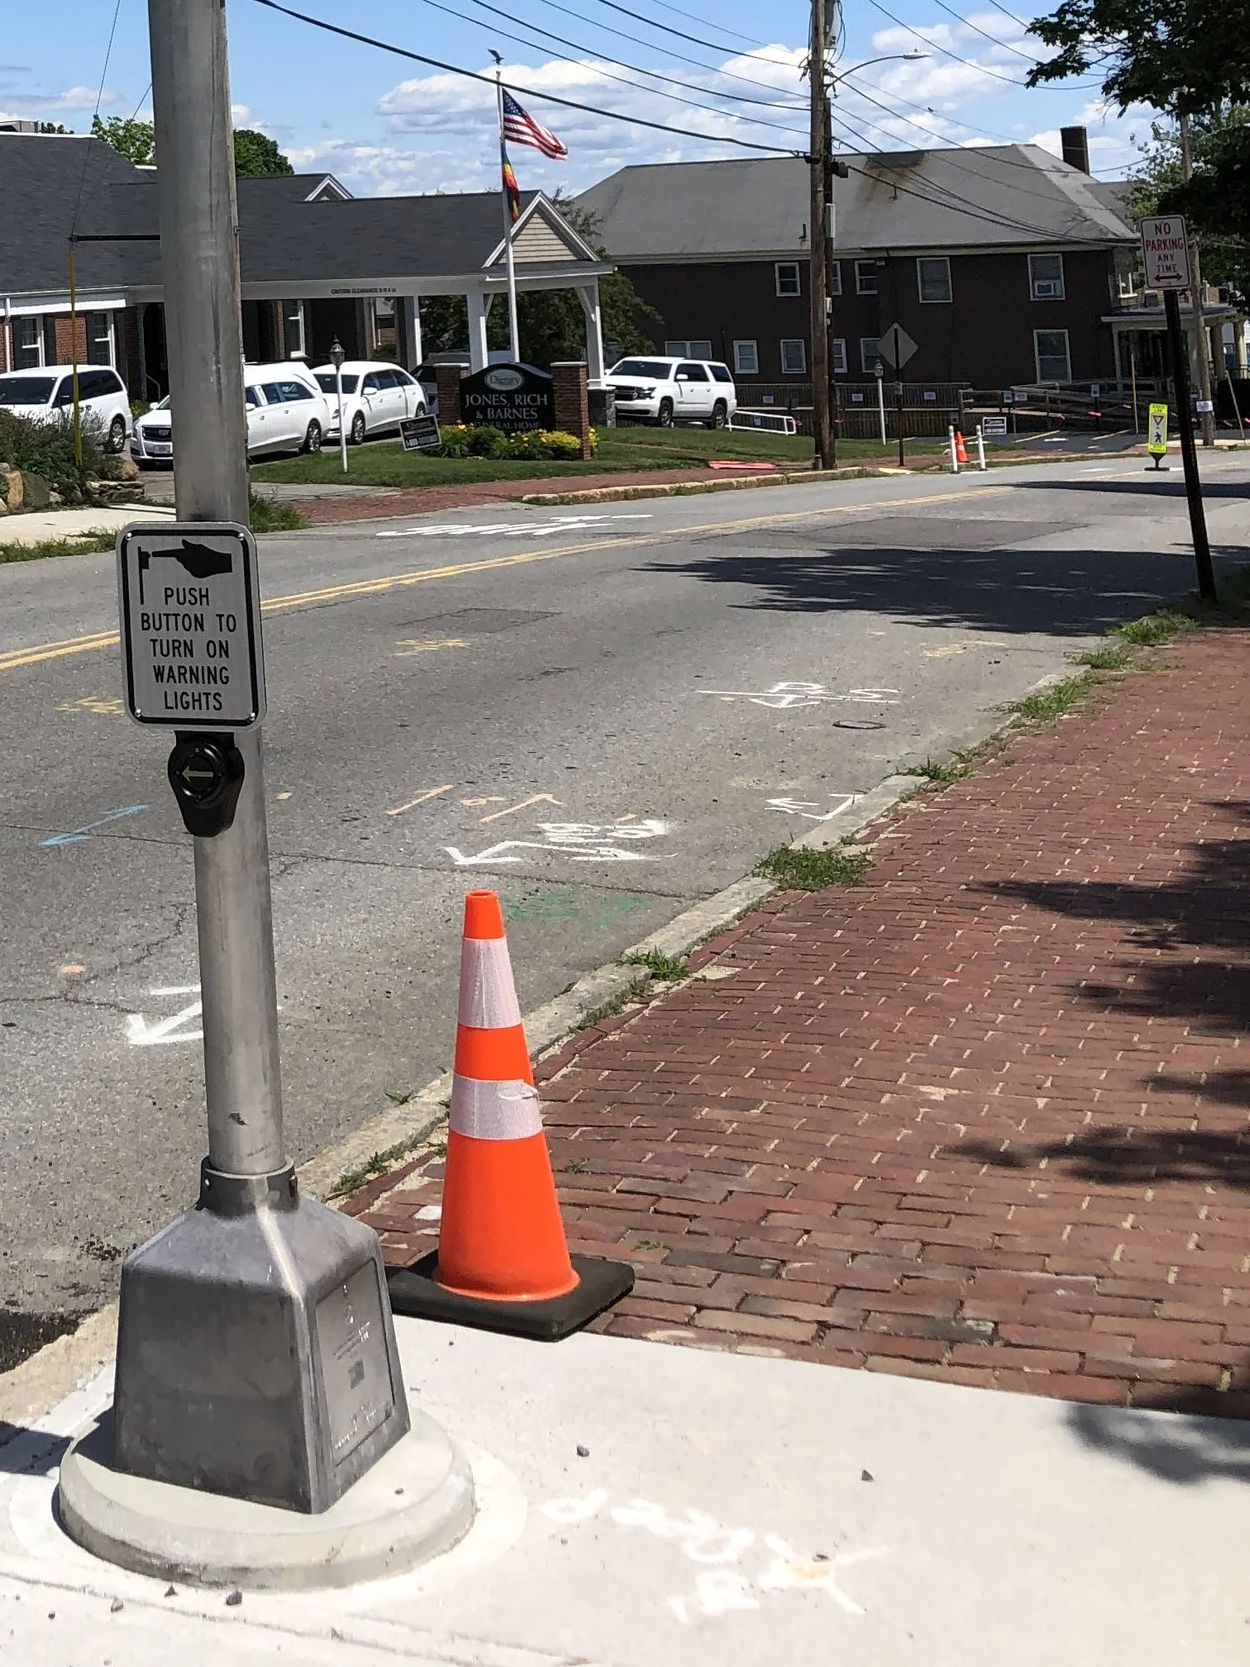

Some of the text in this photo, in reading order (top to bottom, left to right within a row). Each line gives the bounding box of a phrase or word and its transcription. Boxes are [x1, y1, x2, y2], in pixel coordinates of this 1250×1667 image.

[1155, 222, 1171, 235] NO
[1145, 237, 1184, 252] PARKING
[1158, 253, 1174, 262] ANY
[1157, 264, 1177, 273] TIME
[464, 394, 548, 407] JONES, RICH
[476, 407, 538, 420] & BARNES
[164, 586, 209, 606] PUSH
[141, 612, 237, 633] BUTTON TO
[150, 638, 230, 659] TURN ON
[152, 664, 230, 685] WARNING
[164, 690, 223, 712] LIGHTS
